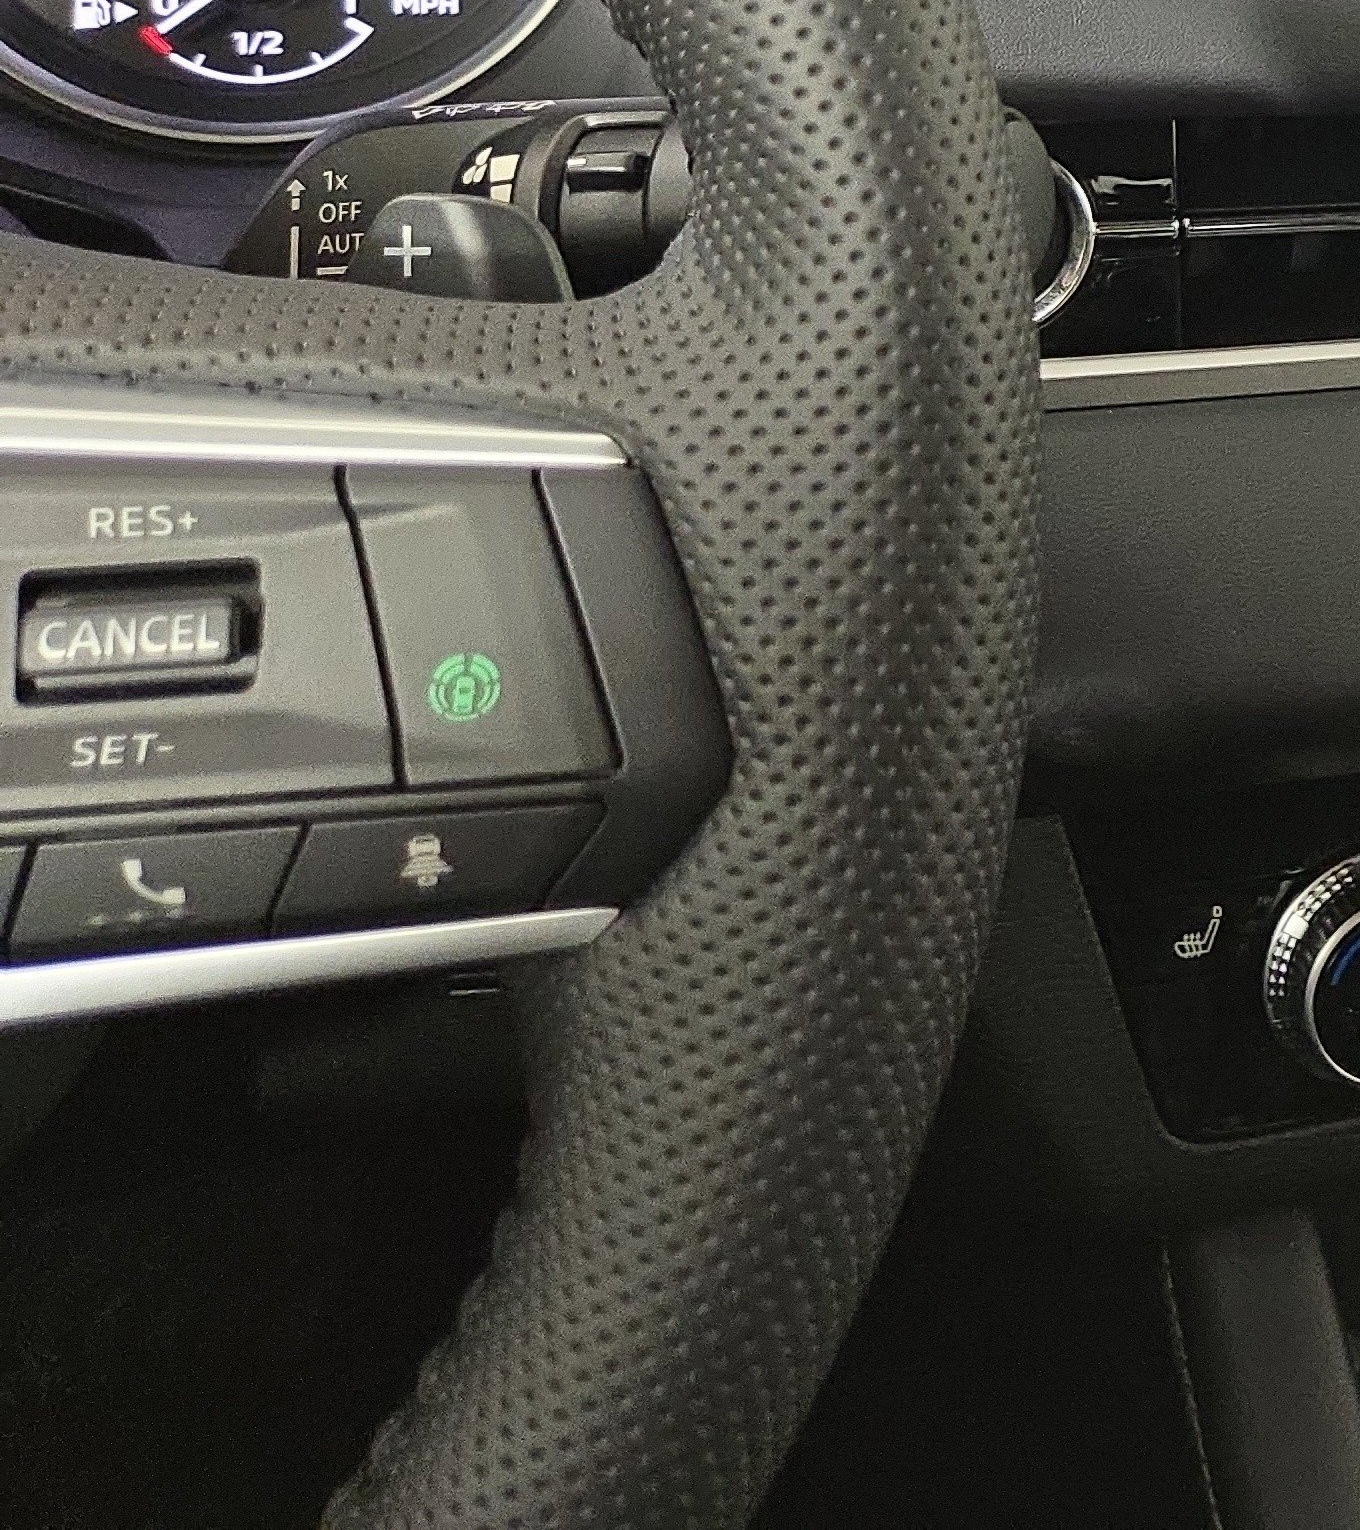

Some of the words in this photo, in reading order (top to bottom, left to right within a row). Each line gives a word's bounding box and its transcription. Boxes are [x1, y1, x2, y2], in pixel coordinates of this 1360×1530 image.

[230, 30, 285, 56] 1/2
[318, 201, 363, 224] OFF
[316, 232, 365, 255] AUT
[88, 504, 199, 539] RES+
[37, 613, 221, 663] CANCEL
[70, 732, 176, 768] SET-
